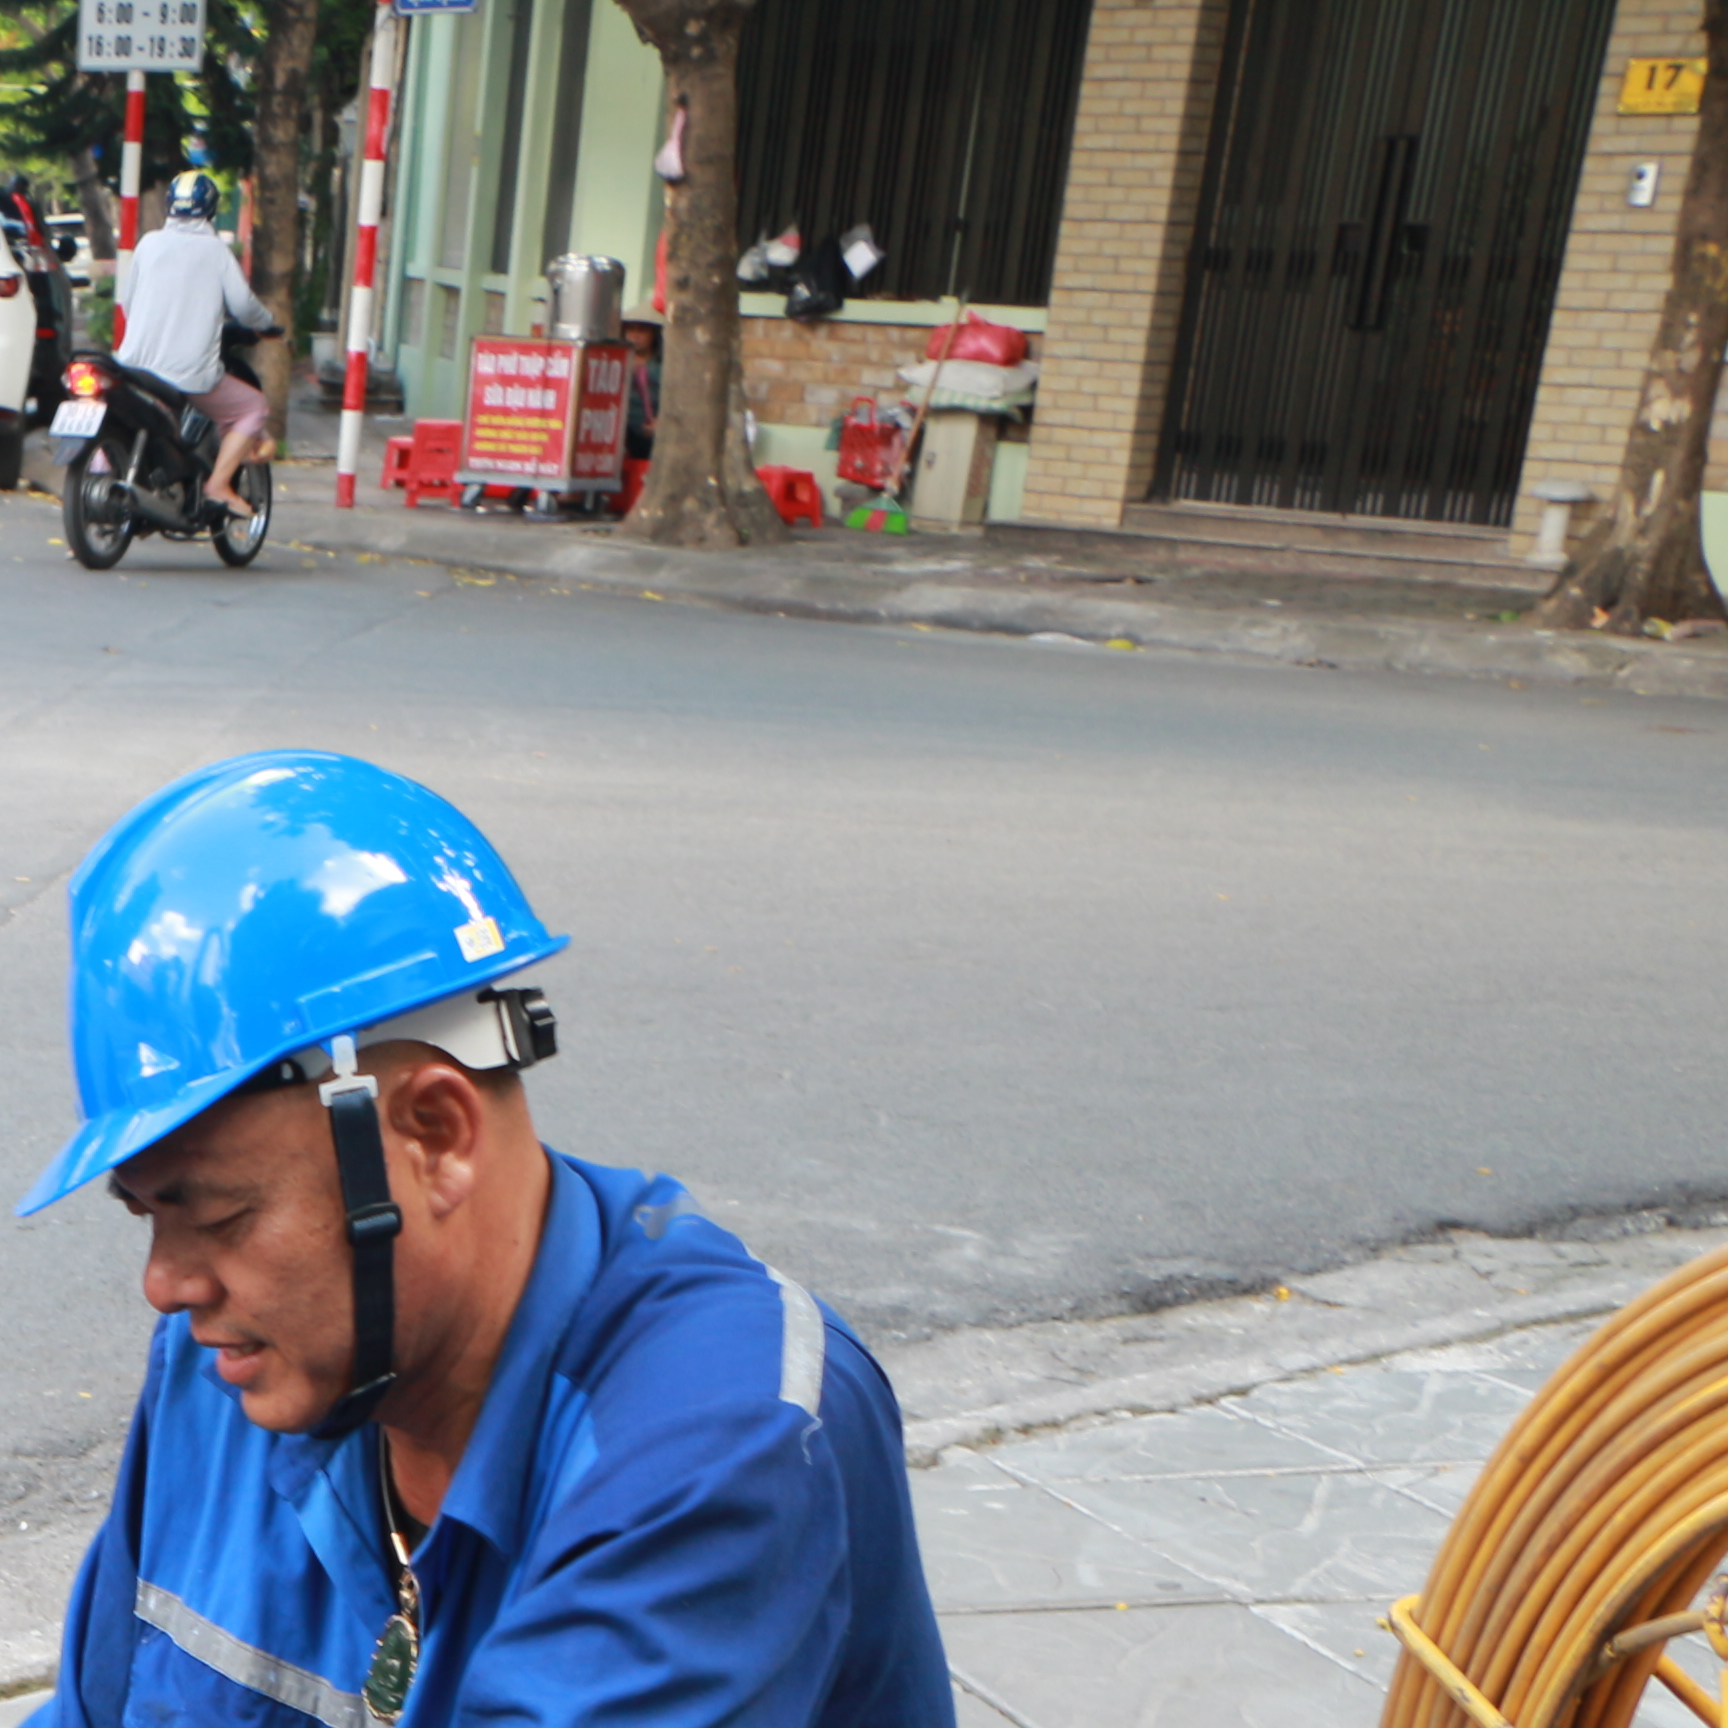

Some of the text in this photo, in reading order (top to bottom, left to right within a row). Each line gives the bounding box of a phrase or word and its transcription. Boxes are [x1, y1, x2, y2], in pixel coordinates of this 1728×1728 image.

[96, 2, 134, 25] 6:00
[159, 2, 197, 25] 9:00
[87, 35, 133, 58] 16:00
[149, 35, 196, 59] 19:30
[1646, 63, 1685, 91] 17
[587, 352, 623, 395] TÀO
